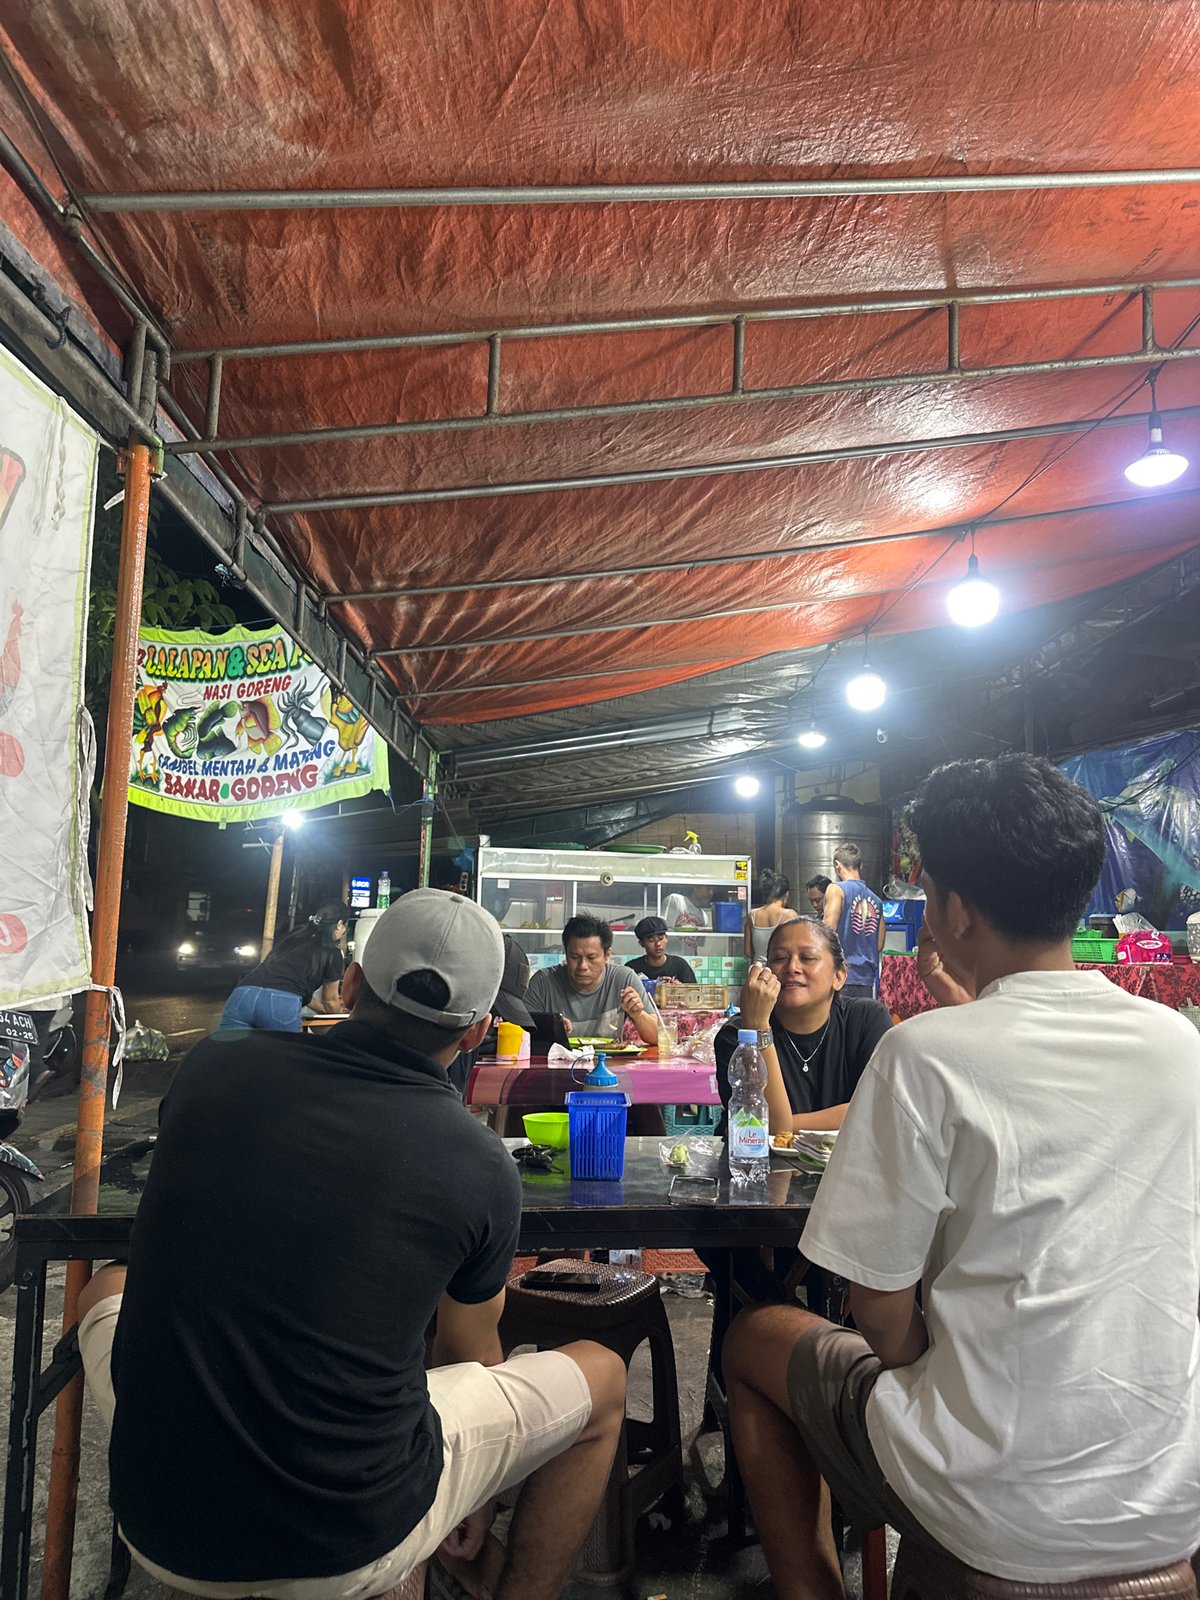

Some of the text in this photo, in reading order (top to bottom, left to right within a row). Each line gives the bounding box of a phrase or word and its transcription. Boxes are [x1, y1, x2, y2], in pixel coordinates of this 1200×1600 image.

[146, 644, 229, 683] LALAPAN
[246, 636, 288, 677] SEA
[203, 675, 292, 700] NASI GORENG
[201, 758, 256, 776] MENTAH
[164, 764, 318, 802] BAKAR GORENG
[749, 1130, 757, 1138] Le
